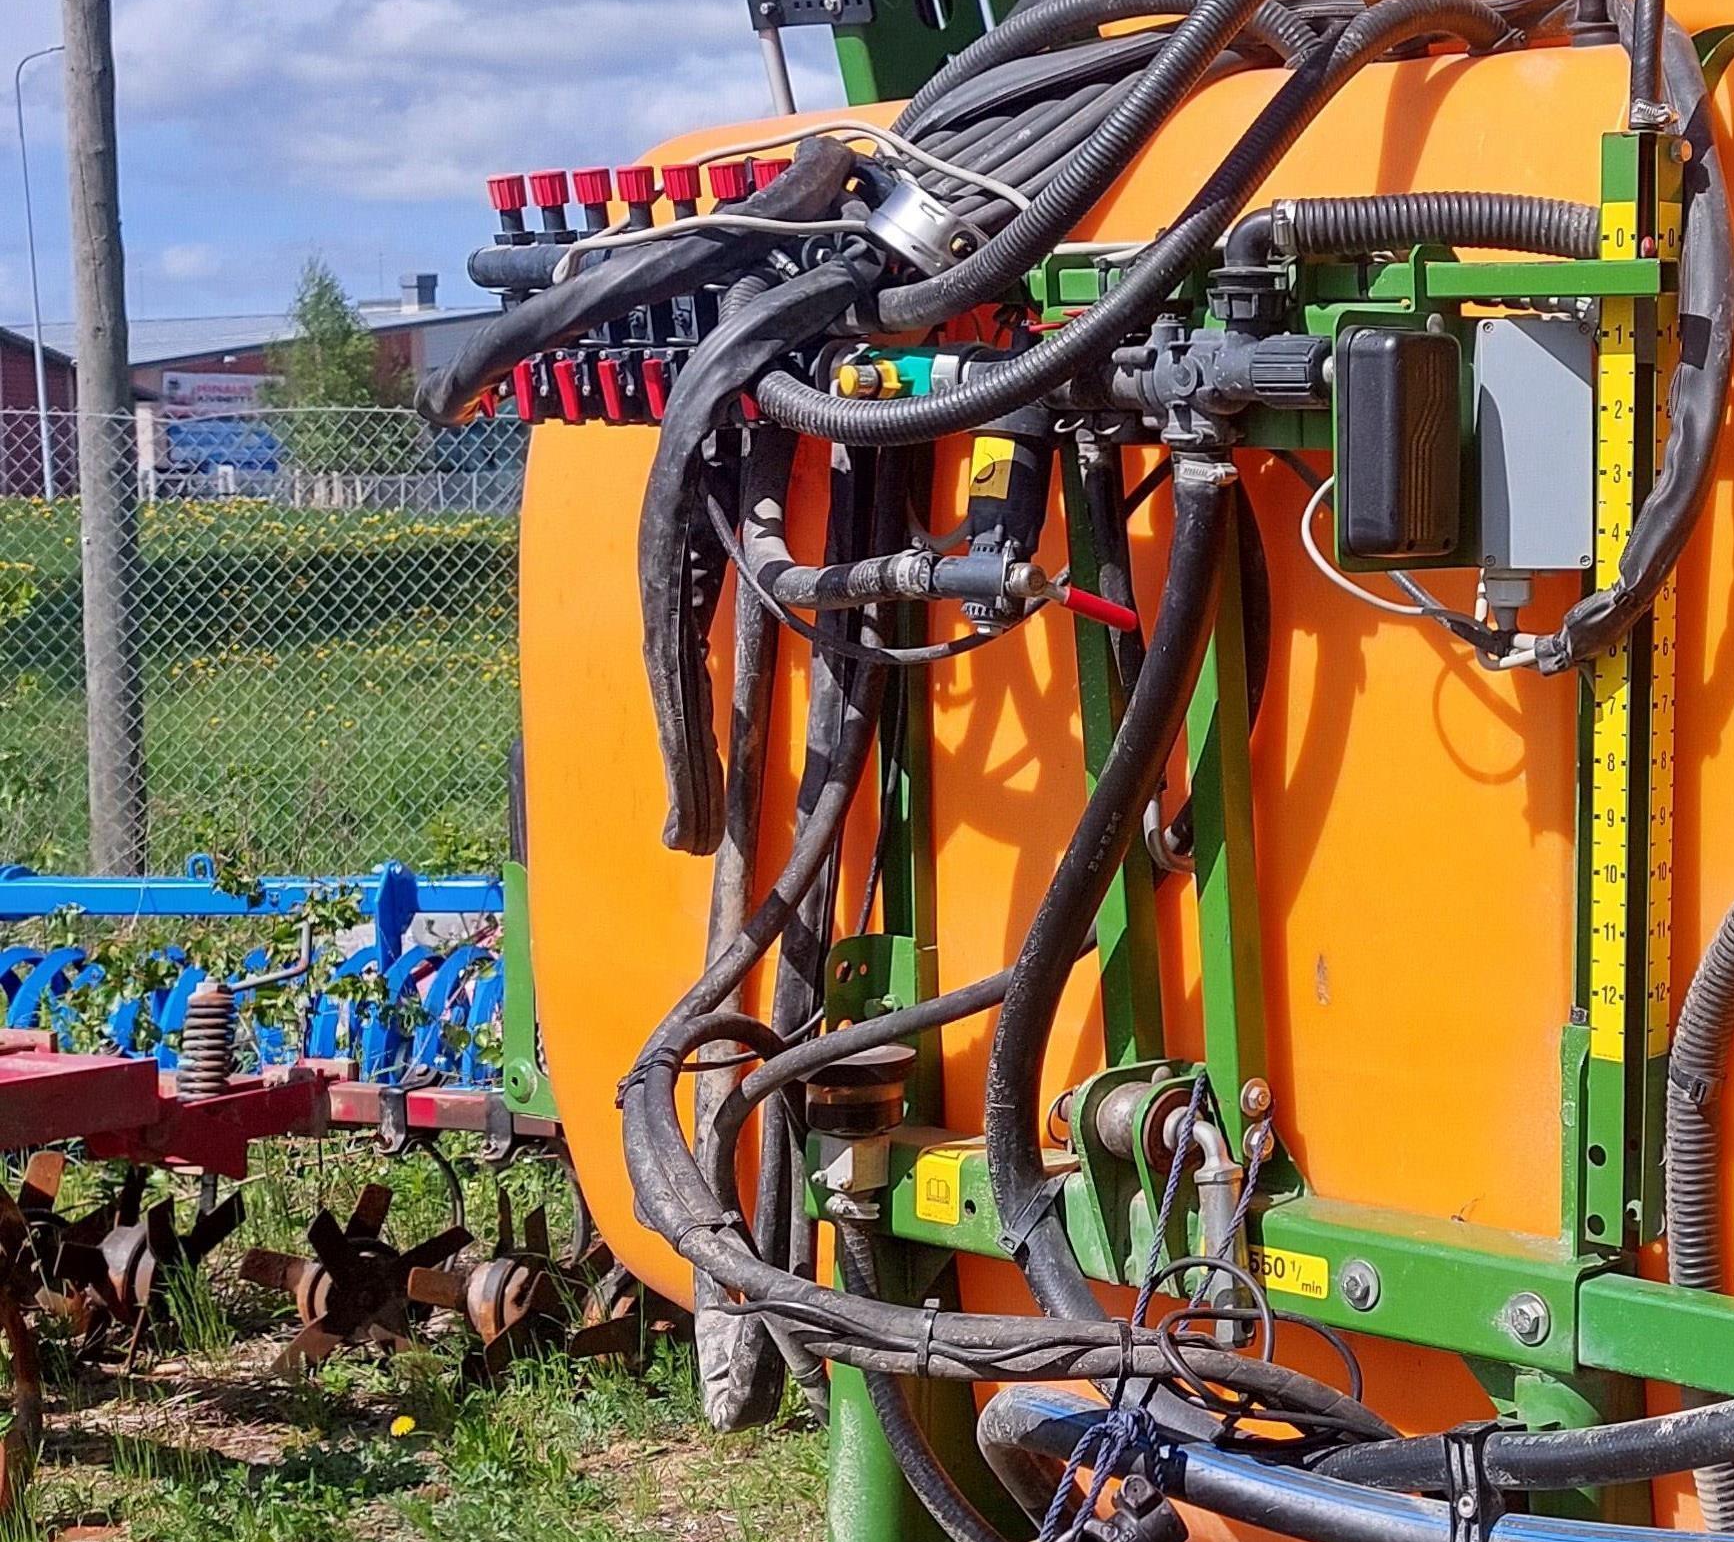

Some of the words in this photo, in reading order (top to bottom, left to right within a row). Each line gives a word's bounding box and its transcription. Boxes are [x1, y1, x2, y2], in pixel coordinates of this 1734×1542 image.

[1616, 227, 1624, 248] 0
[1668, 227, 1675, 248] 0
[1615, 324, 1622, 345] 1
[1666, 324, 1673, 344] 1
[1614, 400, 1622, 420] 2
[1613, 463, 1621, 484] 3
[1612, 523, 1620, 542] 4
[1662, 636, 1669, 657] 6
[1608, 695, 1616, 715] 7
[1662, 694, 1668, 714] 7
[1607, 752, 1615, 771] 8
[1661, 750, 1667, 770] 8
[1607, 809, 1614, 827] 9
[1660, 806, 1666, 826] 9
[1603, 864, 1617, 884] 10
[1657, 861, 1667, 881] 10
[1603, 922, 1616, 942] 11
[1656, 919, 1666, 939] 11
[1601, 985, 1617, 1005] 12
[1655, 982, 1666, 1003] 12
